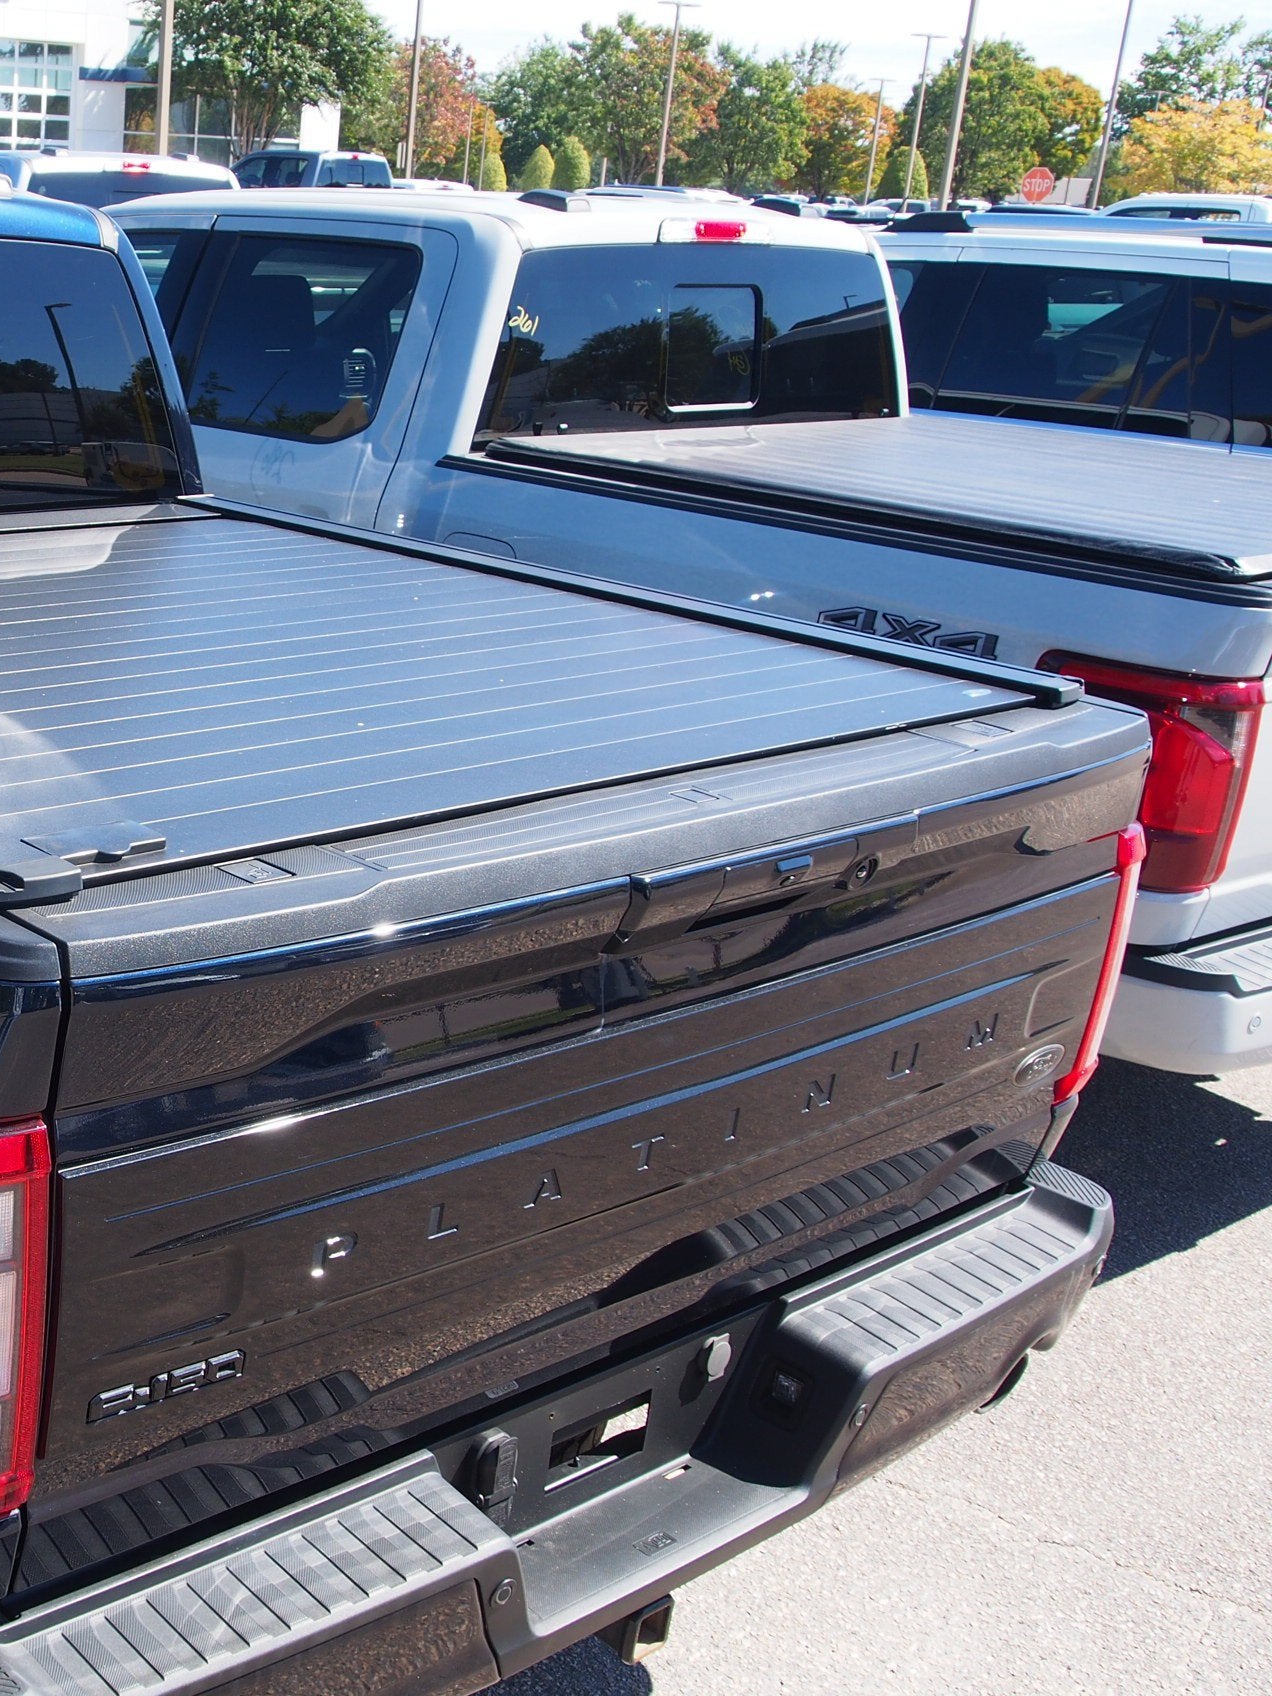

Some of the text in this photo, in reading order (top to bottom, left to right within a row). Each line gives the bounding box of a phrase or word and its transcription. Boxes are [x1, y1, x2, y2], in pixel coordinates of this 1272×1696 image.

[1023, 179, 1050, 191] STOP
[508, 305, 539, 336] 261
[311, 1013, 998, 1277] PLATINUM
